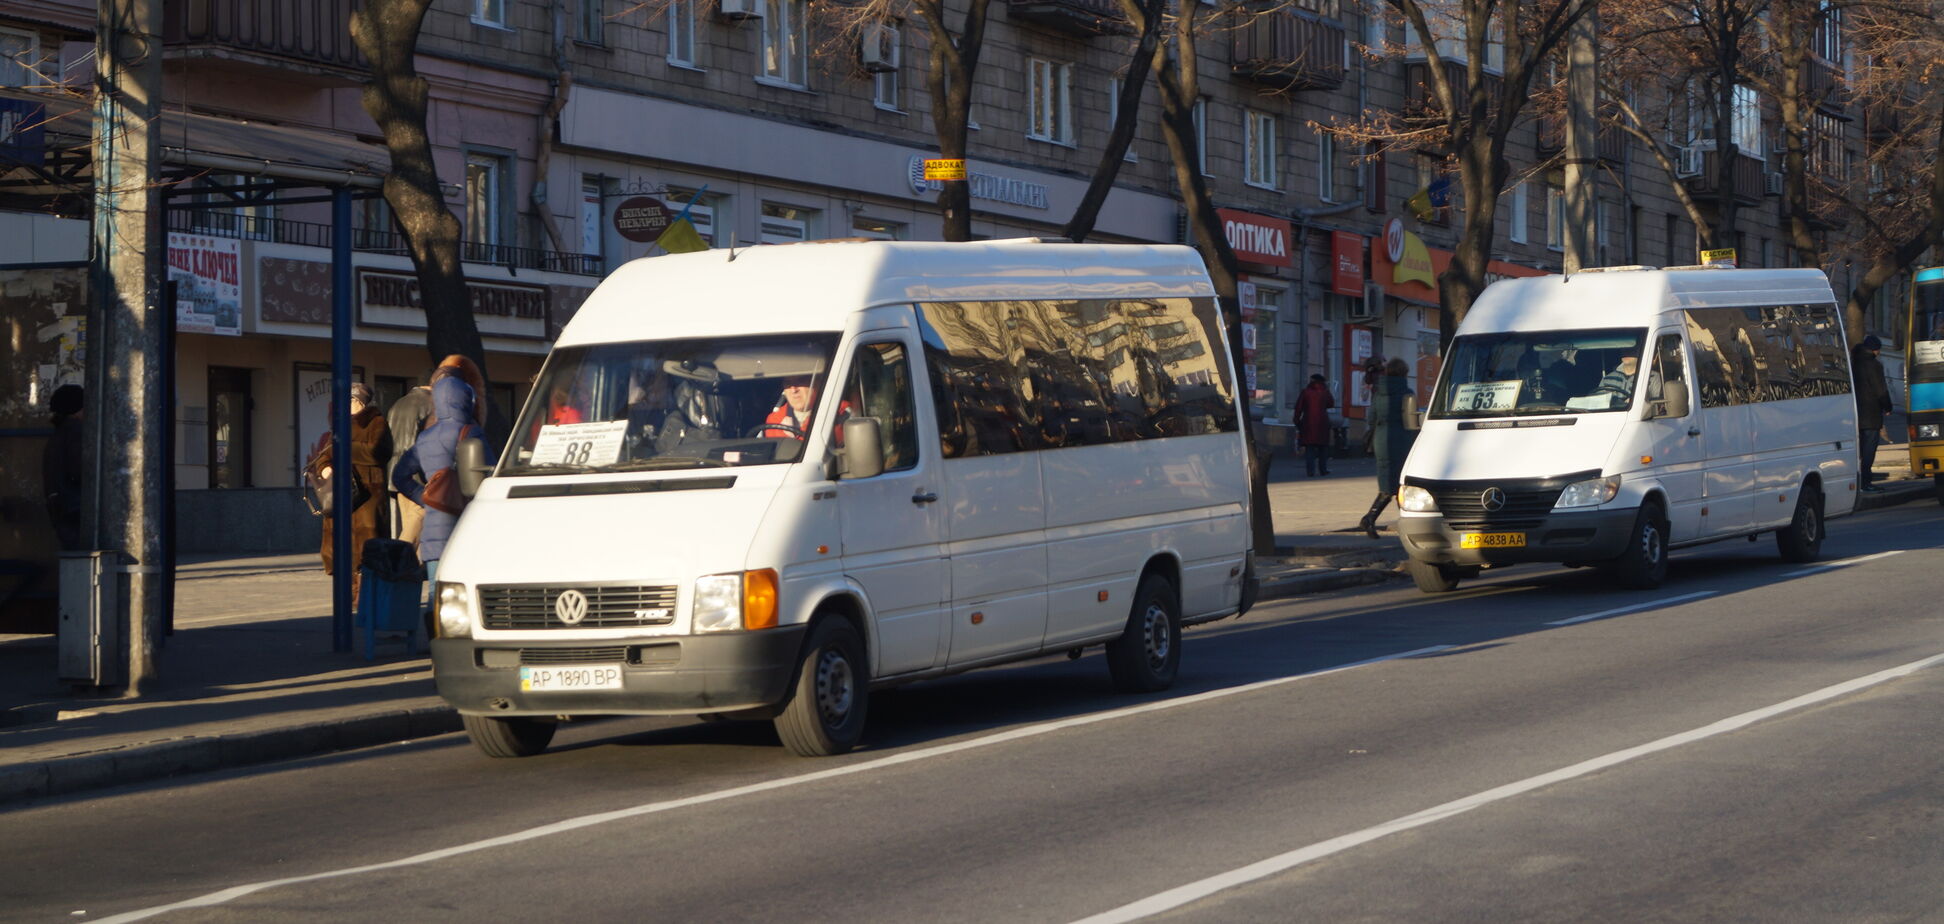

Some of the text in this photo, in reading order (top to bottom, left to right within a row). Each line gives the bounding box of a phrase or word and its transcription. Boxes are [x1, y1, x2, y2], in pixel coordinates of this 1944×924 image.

[925, 161, 965, 169] АДВОКАТ
[621, 206, 662, 218] ВЛАСНА
[619, 216, 667, 229] ПЕКАРНЯ
[1226, 220, 1286, 257] ОПТИКА
[193, 243, 238, 286] КЛЮЧЕЙ
[364, 274, 545, 319] ВЛАС ЕКАРНЯ
[563, 441, 593, 465] 88
[1484, 534, 1507, 545] 4838
[1509, 534, 1524, 545] AA
[532, 668, 617, 687] AP 1890 BP
